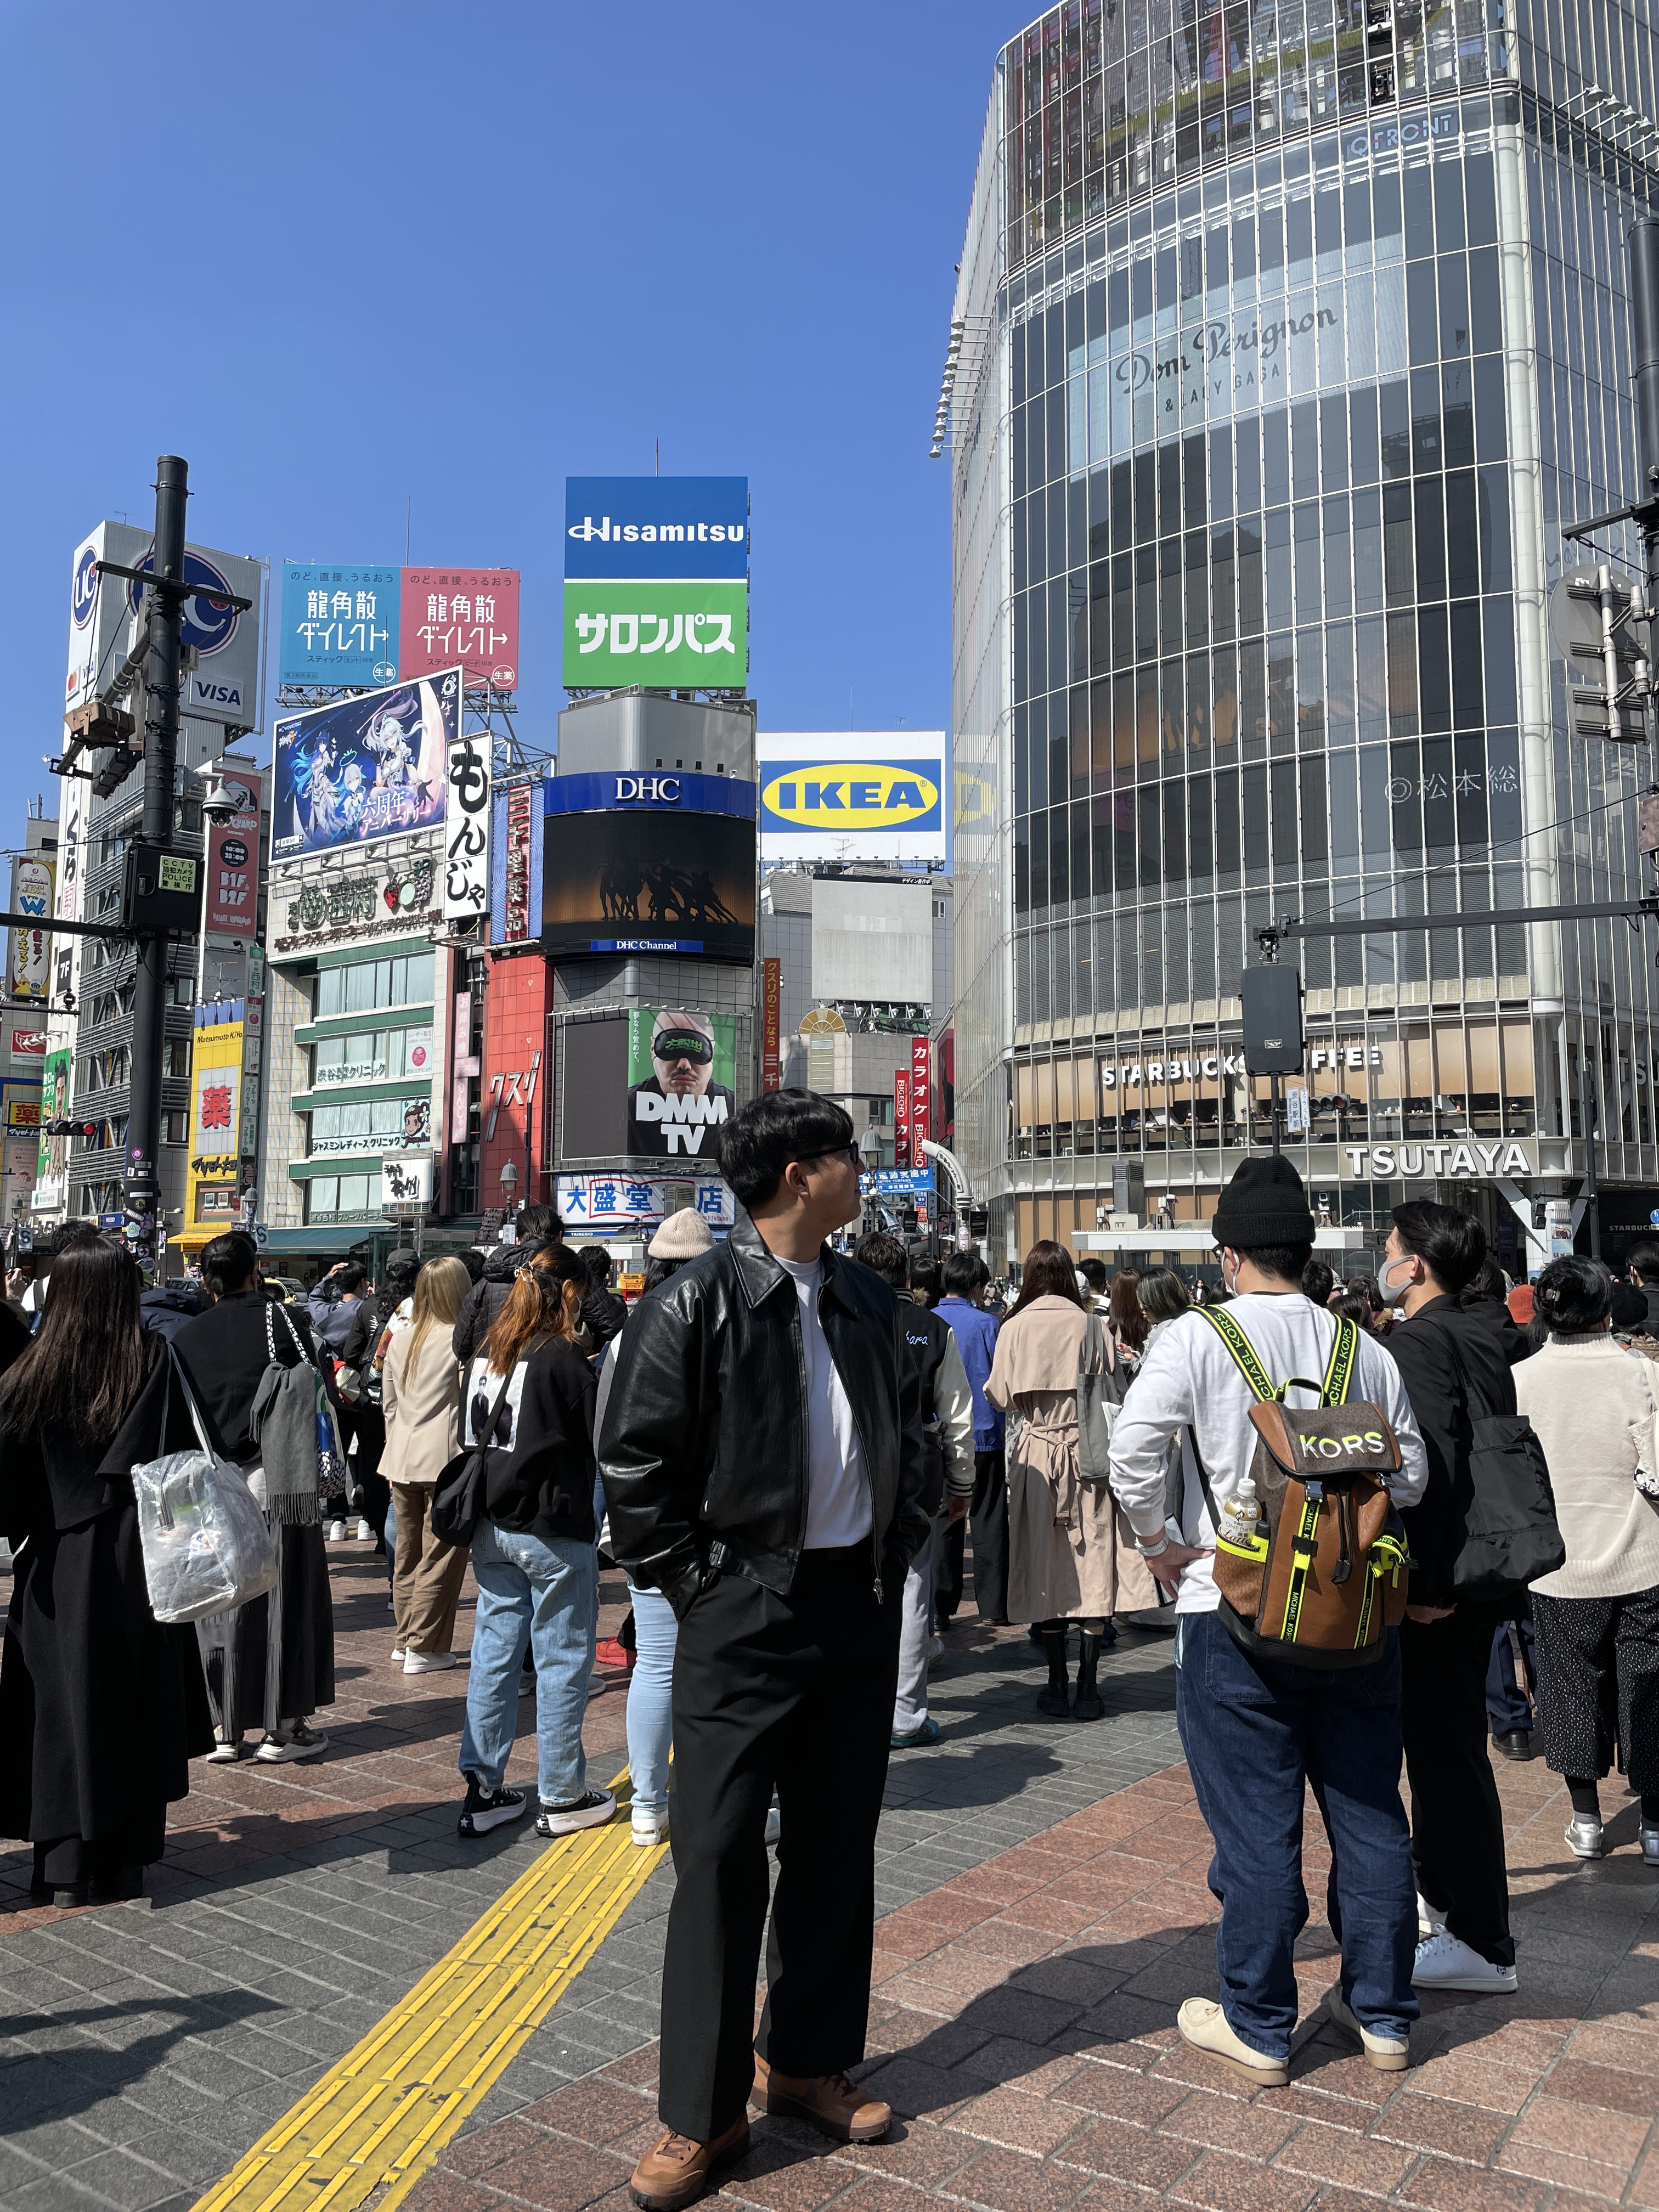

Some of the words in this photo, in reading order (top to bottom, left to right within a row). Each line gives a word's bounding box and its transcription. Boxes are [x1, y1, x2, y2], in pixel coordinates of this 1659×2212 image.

[1351, 114, 1452, 156] QFRONT
[1116, 354, 1191, 394] Dom
[1182, 380, 1222, 407] LAY
[568, 517, 744, 541] Hisamitsu
[75, 562, 95, 608] UC
[291, 572, 393, 583] のど、直接、うるおう
[410, 575, 512, 586] のど、直接、うるおう
[307, 590, 377, 620] 龍角散
[427, 593, 495, 623] 龍角散
[296, 622, 389, 652] ダイレクト
[416, 625, 508, 654] ダイレクト
[575, 613, 735, 653] サロンパス
[375, 668, 394, 677] 生薬
[494, 671, 512, 680] 生薬
[193, 680, 241, 706] VISA
[615, 777, 680, 800] DHC
[779, 782, 927, 809] IKEA
[360, 791, 407, 818] 六周年
[361, 808, 432, 834] アニバーサリー
[448, 741, 488, 909] もんじゃ
[162, 866, 194, 876] 防犯カメラ
[162, 872, 193, 883] POLICE
[162, 880, 193, 890] 警視庁
[220, 871, 247, 888] B1F
[219, 888, 247, 905] B2F
[616, 941, 638, 949] DHC
[639, 941, 677, 950] Channel
[60, 960, 70, 979] 7F
[766, 962, 777, 1047] クスリのことなら
[197, 1034, 229, 1043] Matsumoto
[229, 1031, 244, 1041] KiYo
[913, 1047, 928, 1115] カラオケ
[1103, 1050, 1246, 1086] STARBUCKS
[15, 1104, 40, 1124] 薬
[201, 1086, 231, 1129] 薬
[636, 1090, 729, 1124] DMM
[661, 1124, 706, 1154] TV
[896, 1125, 908, 1168] カラオ
[915, 1124, 924, 1141] BIG
[915, 1143, 924, 1167] ECHO
[1345, 1143, 1531, 1176] TSUTAYA
[878, 1169, 929, 1180] 運動実施中
[566, 1183, 723, 1214] 大盛堂店
[1215, 1313, 1244, 1348] KORS
[1339, 1327, 1352, 1359] KORS
[1242, 1349, 1273, 1401] ICHAEL
[1299, 1431, 1386, 1460] KORS
[1289, 1592, 1299, 1624] MICHAEL
[1361, 1598, 1370, 1630] MICHAEL
